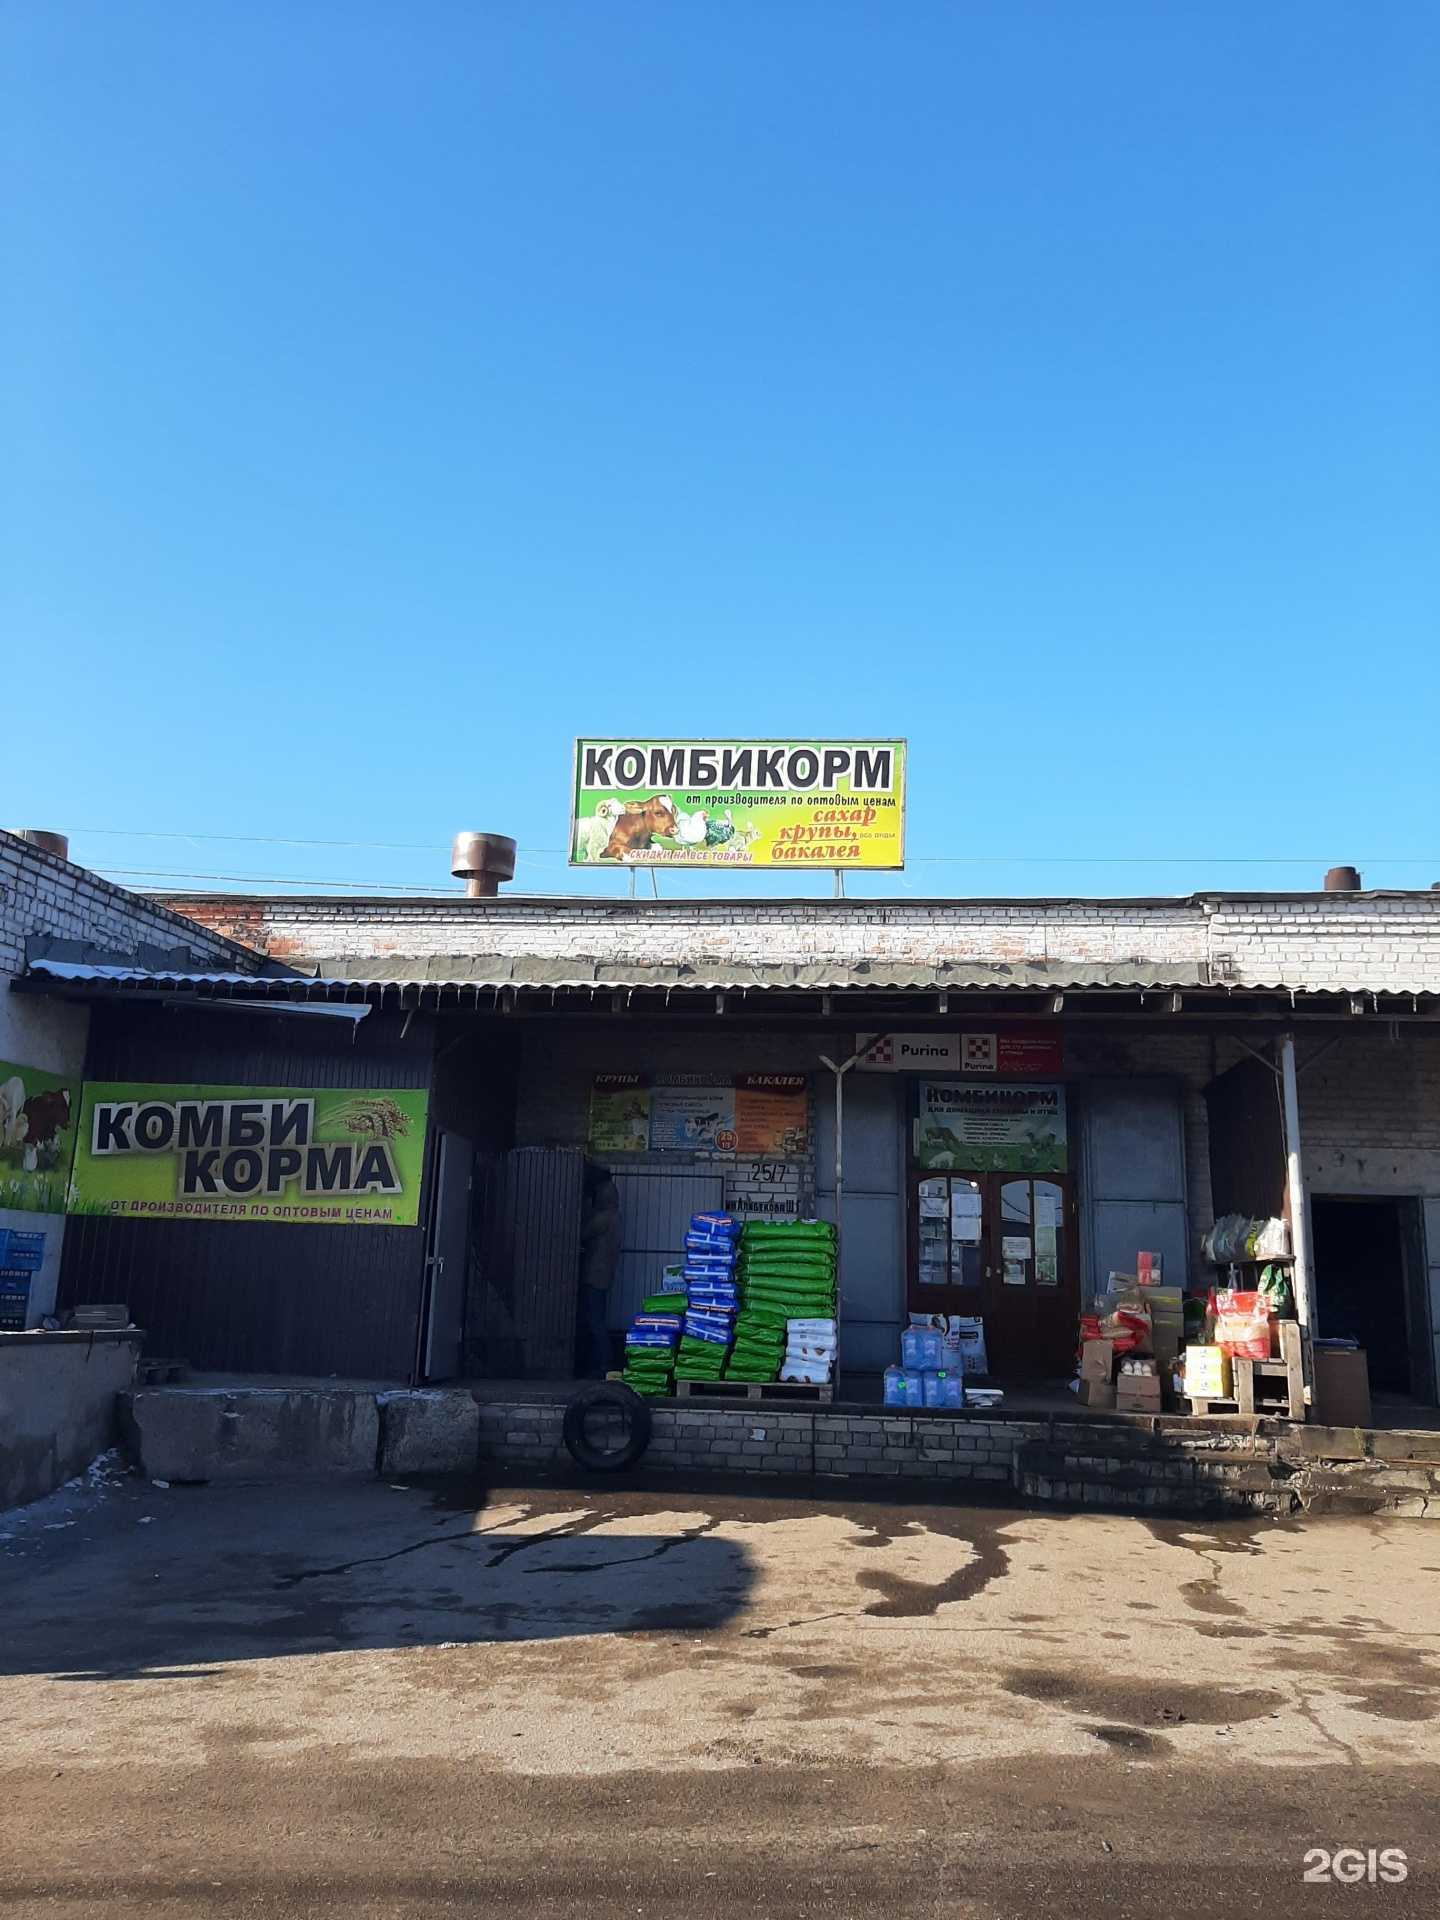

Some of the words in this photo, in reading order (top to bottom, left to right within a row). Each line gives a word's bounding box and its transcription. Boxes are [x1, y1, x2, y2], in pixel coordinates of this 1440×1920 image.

[585, 748, 891, 789] КОМБИКОРМ
[686, 796, 701, 805] от
[705, 793, 786, 808] производителя
[791, 797, 803, 806] по
[807, 793, 859, 806] оптовым
[863, 798, 896, 808] ценам
[813, 806, 877, 826] сахар
[779, 823, 857, 844] крупы,
[629, 848, 670, 860] СКИДКИ
[672, 850, 688, 859] НА
[690, 851, 708, 860] ВСЕ
[712, 852, 753, 862] ТОВАРЫ
[771, 841, 861, 859] бакалея
[901, 1044, 949, 1057] Purina
[96, 1102, 310, 1151] КОМБИ
[183, 1146, 397, 1193] КОРМА
[111, 1200, 127, 1212] ОТ
[130, 1202, 246, 1216] ПРОИЗВОДИТЕЛЯ
[250, 1204, 269, 1216] ПО
[273, 1205, 342, 1218] ОПТОВЫМ
[345, 1207, 393, 1220] ЦЕНАМ
